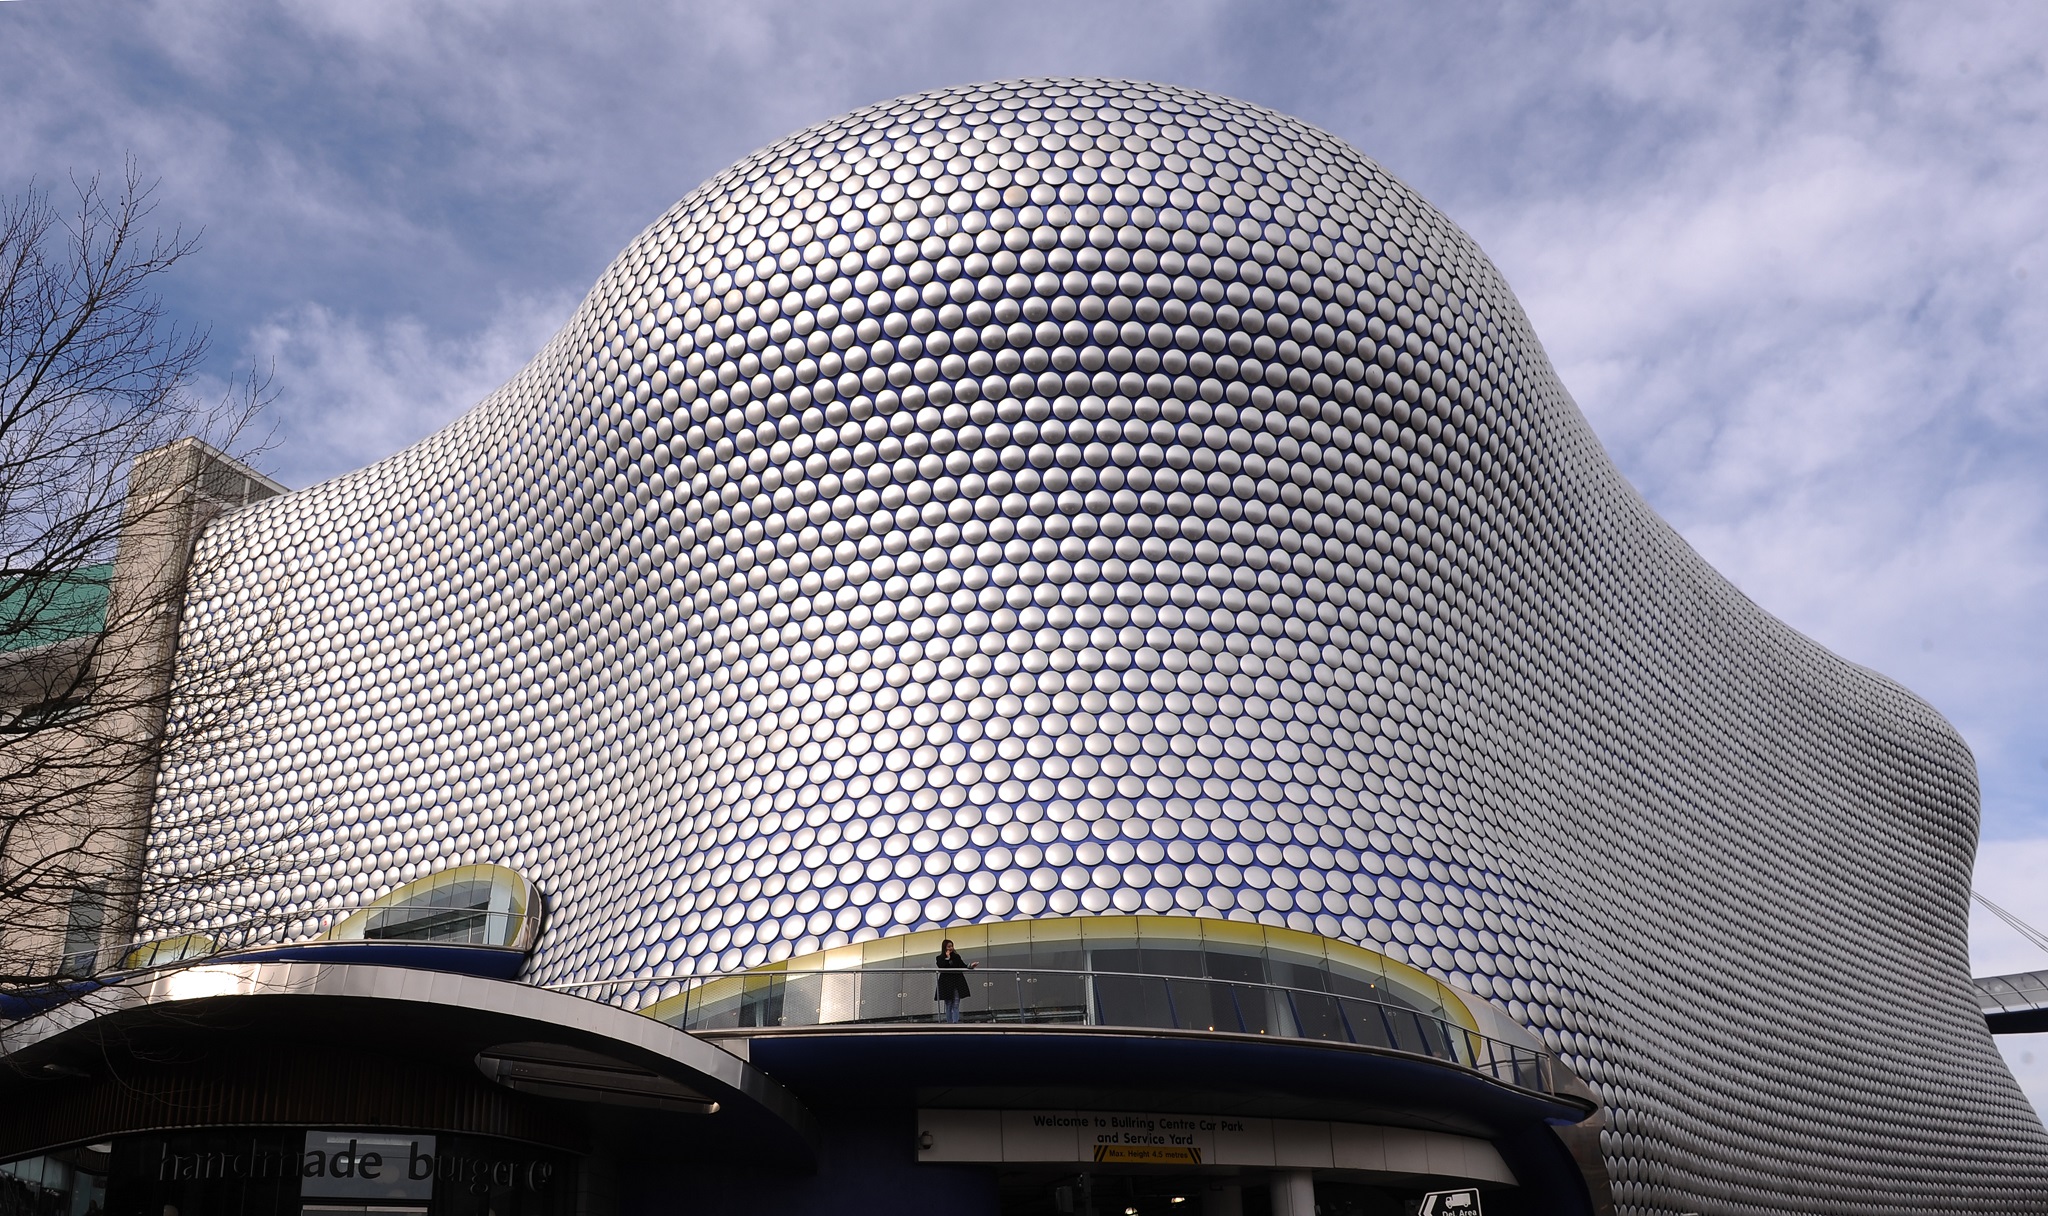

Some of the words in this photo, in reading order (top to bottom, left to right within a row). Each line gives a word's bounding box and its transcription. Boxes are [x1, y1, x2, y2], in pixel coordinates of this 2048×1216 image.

[1033, 1115, 1089, 1127] Welcome
[1094, 1116, 1106, 1127] to
[1111, 1117, 1155, 1131] Bullring
[1159, 1118, 1196, 1130] Centre
[1199, 1120, 1217, 1131] Car
[1221, 1121, 1244, 1132] Park
[1097, 1133, 1119, 1143] and
[1124, 1133, 1165, 1144] Service
[1169, 1134, 1193, 1145] Yard
[1109, 1149, 1125, 1158] Max.
[1128, 1150, 1150, 1160] Height
[1165, 1151, 1188, 1159] metres
[158, 1138, 382, 1181] handmade
[408, 1141, 518, 1194] burger
